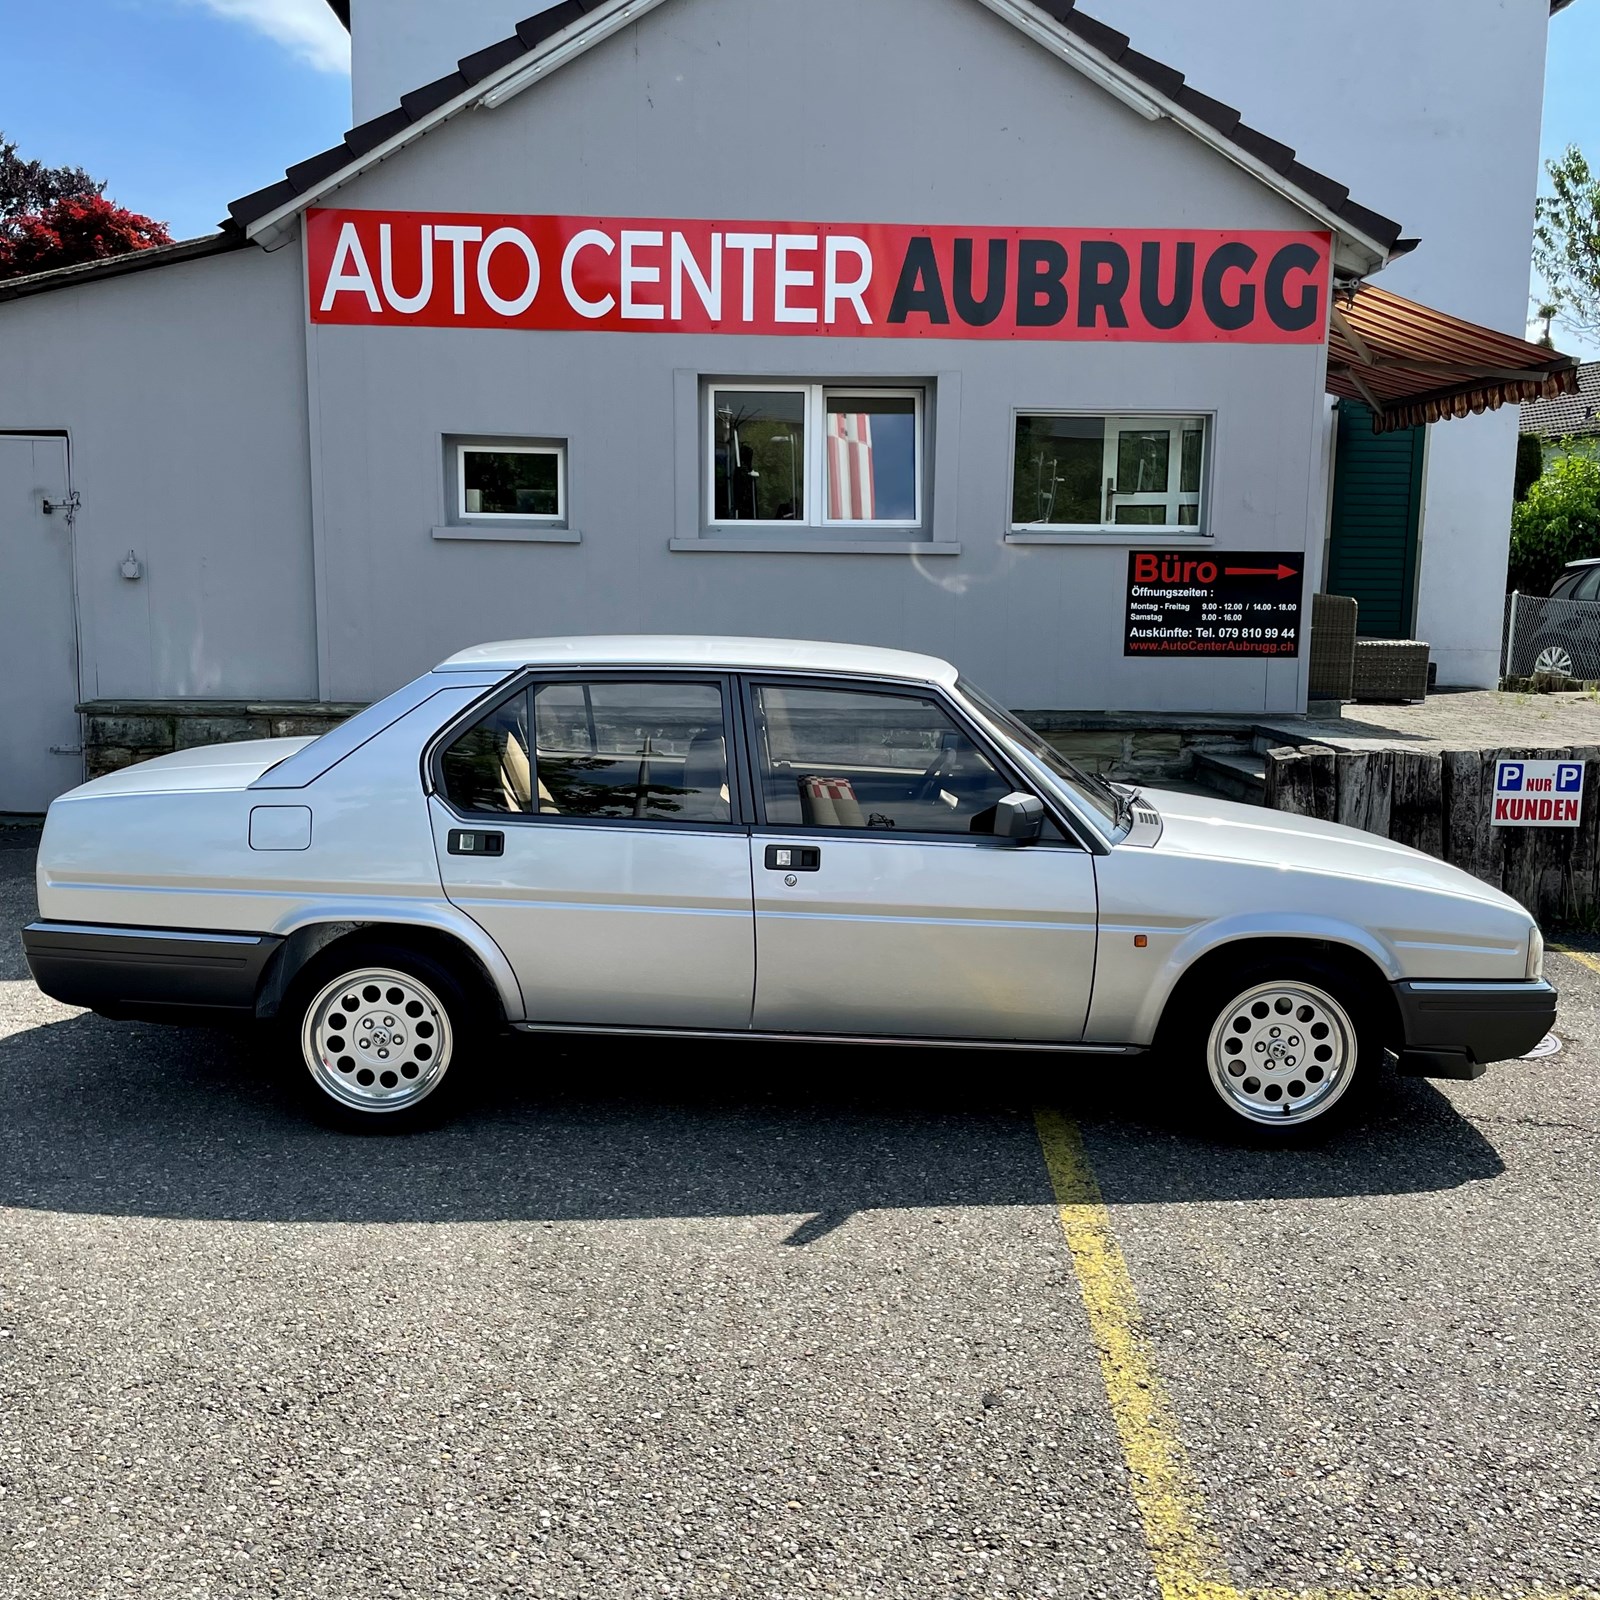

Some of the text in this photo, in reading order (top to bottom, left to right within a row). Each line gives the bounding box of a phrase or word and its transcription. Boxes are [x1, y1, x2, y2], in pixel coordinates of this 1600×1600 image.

[319, 222, 1321, 332] AUTO CENTER AUBRUGG
[1134, 553, 1218, 583] Büro
[1131, 586, 1207, 598] Öffnungszeiten
[1130, 602, 1158, 612] Montag
[1164, 602, 1190, 612] Freitag
[1201, 603, 1217, 611] 9.00
[1223, 603, 1243, 611] 12.00
[1253, 603, 1272, 611] 14.00
[1278, 603, 1297, 611] 18.00
[1130, 613, 1163, 622] Samstag
[1201, 613, 1217, 621] 9.00
[1223, 613, 1243, 621] 16.00
[1129, 627, 1295, 639] Auskünfte: Tel. 079 810 99 44
[1129, 640, 1294, 653] www.AutoCenterAubrugg.ch
[1501, 766, 1578, 791] P NUR P
[1495, 799, 1578, 820] KUNDEN
